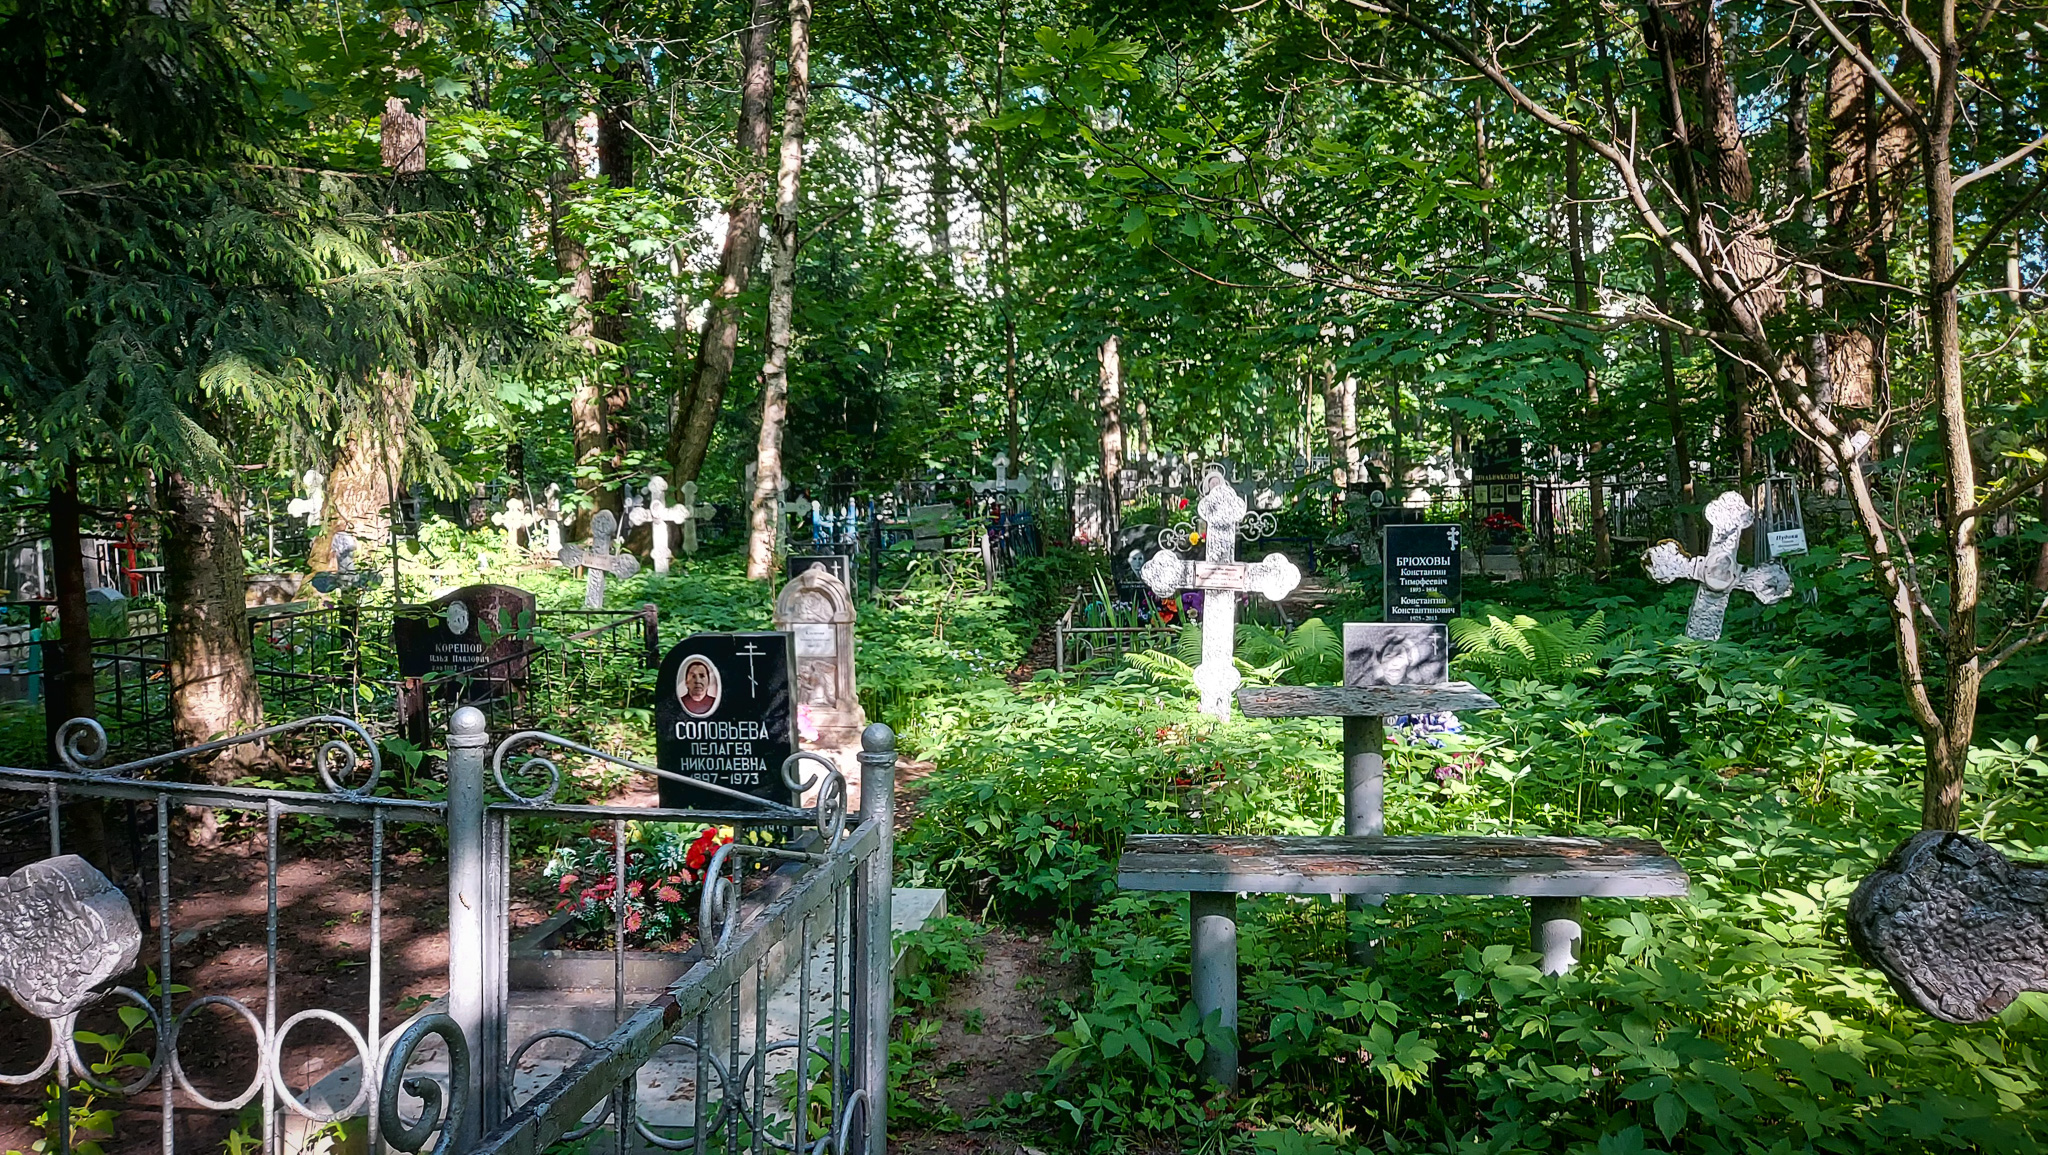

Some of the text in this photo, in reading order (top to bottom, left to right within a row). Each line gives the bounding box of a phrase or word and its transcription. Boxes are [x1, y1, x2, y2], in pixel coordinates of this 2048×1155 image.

[1396, 556, 1451, 566] БРЮХОВЫ
[1400, 568, 1447, 576] Константин
[1399, 577, 1448, 587] Тимофеевич
[1400, 596, 1447, 604] Константин
[1392, 606, 1456, 614] Константинович
[435, 643, 482, 653] КОРЕШОВ
[675, 721, 770, 740] СОЛОВЬЕВА
[691, 742, 752, 756] ПЕЛАГЕЯ
[680, 757, 767, 771] НИКОЛАЕВНА
